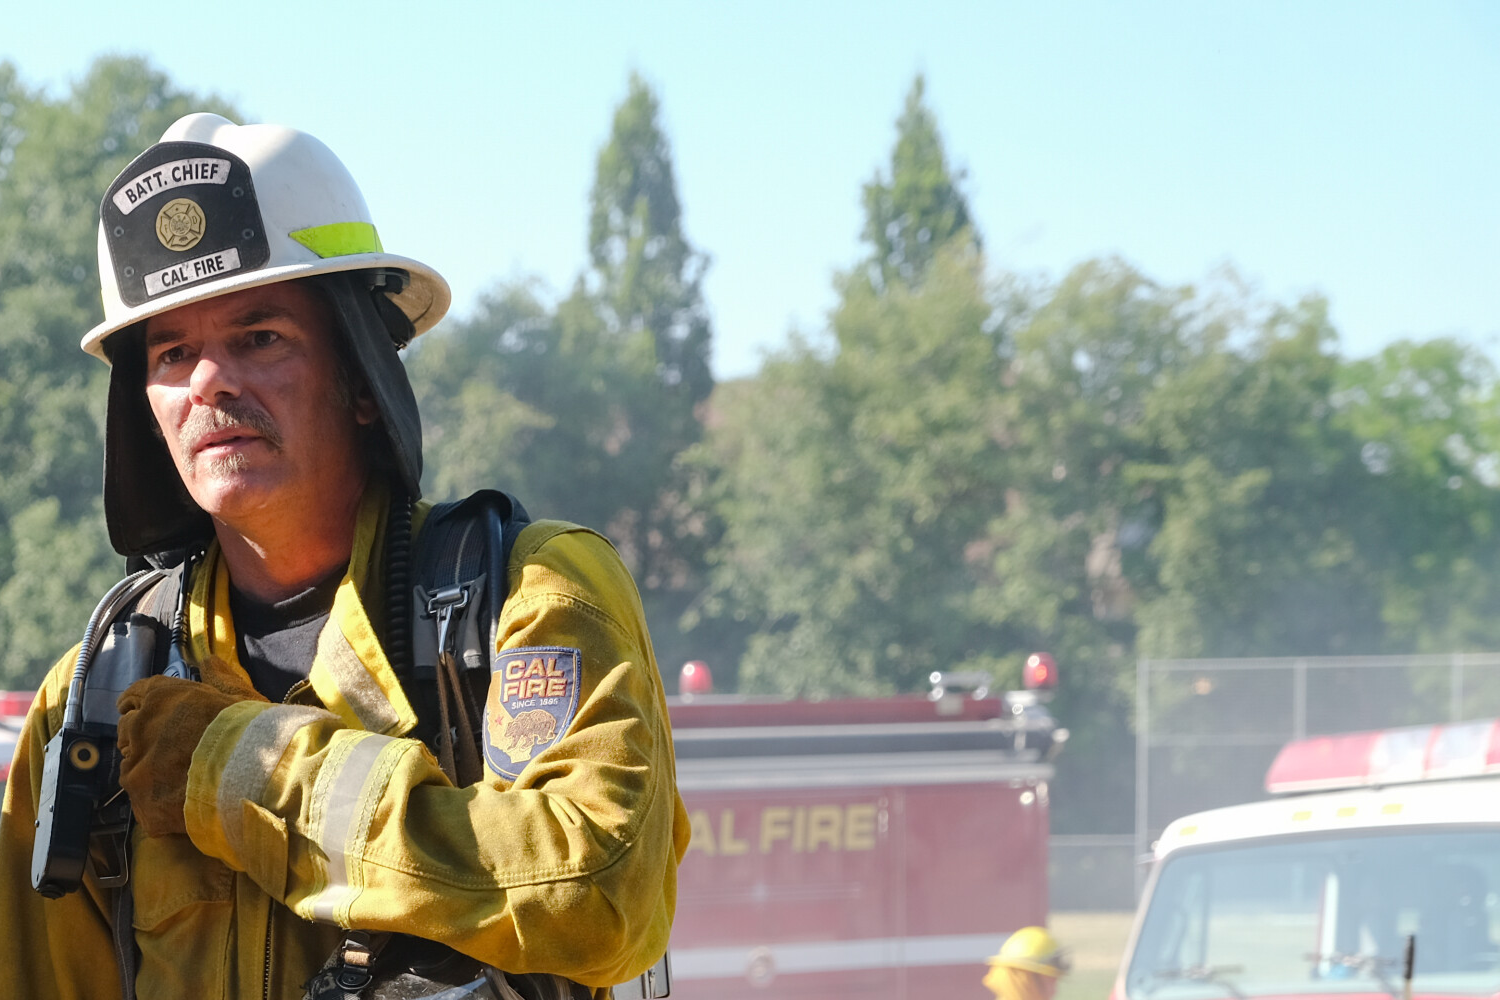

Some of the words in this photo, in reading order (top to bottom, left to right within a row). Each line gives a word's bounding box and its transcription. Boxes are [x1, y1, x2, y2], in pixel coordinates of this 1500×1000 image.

[125, 171, 168, 204] BATT.
[171, 163, 219, 183] CHIEF
[161, 267, 188, 287] CAL
[193, 255, 225, 277] FIRE
[506, 657, 564, 680] CAL
[503, 678, 568, 703] FIRE
[511, 699, 536, 710] SINCE
[688, 808, 749, 858] AL
[760, 803, 878, 855] FIRE
